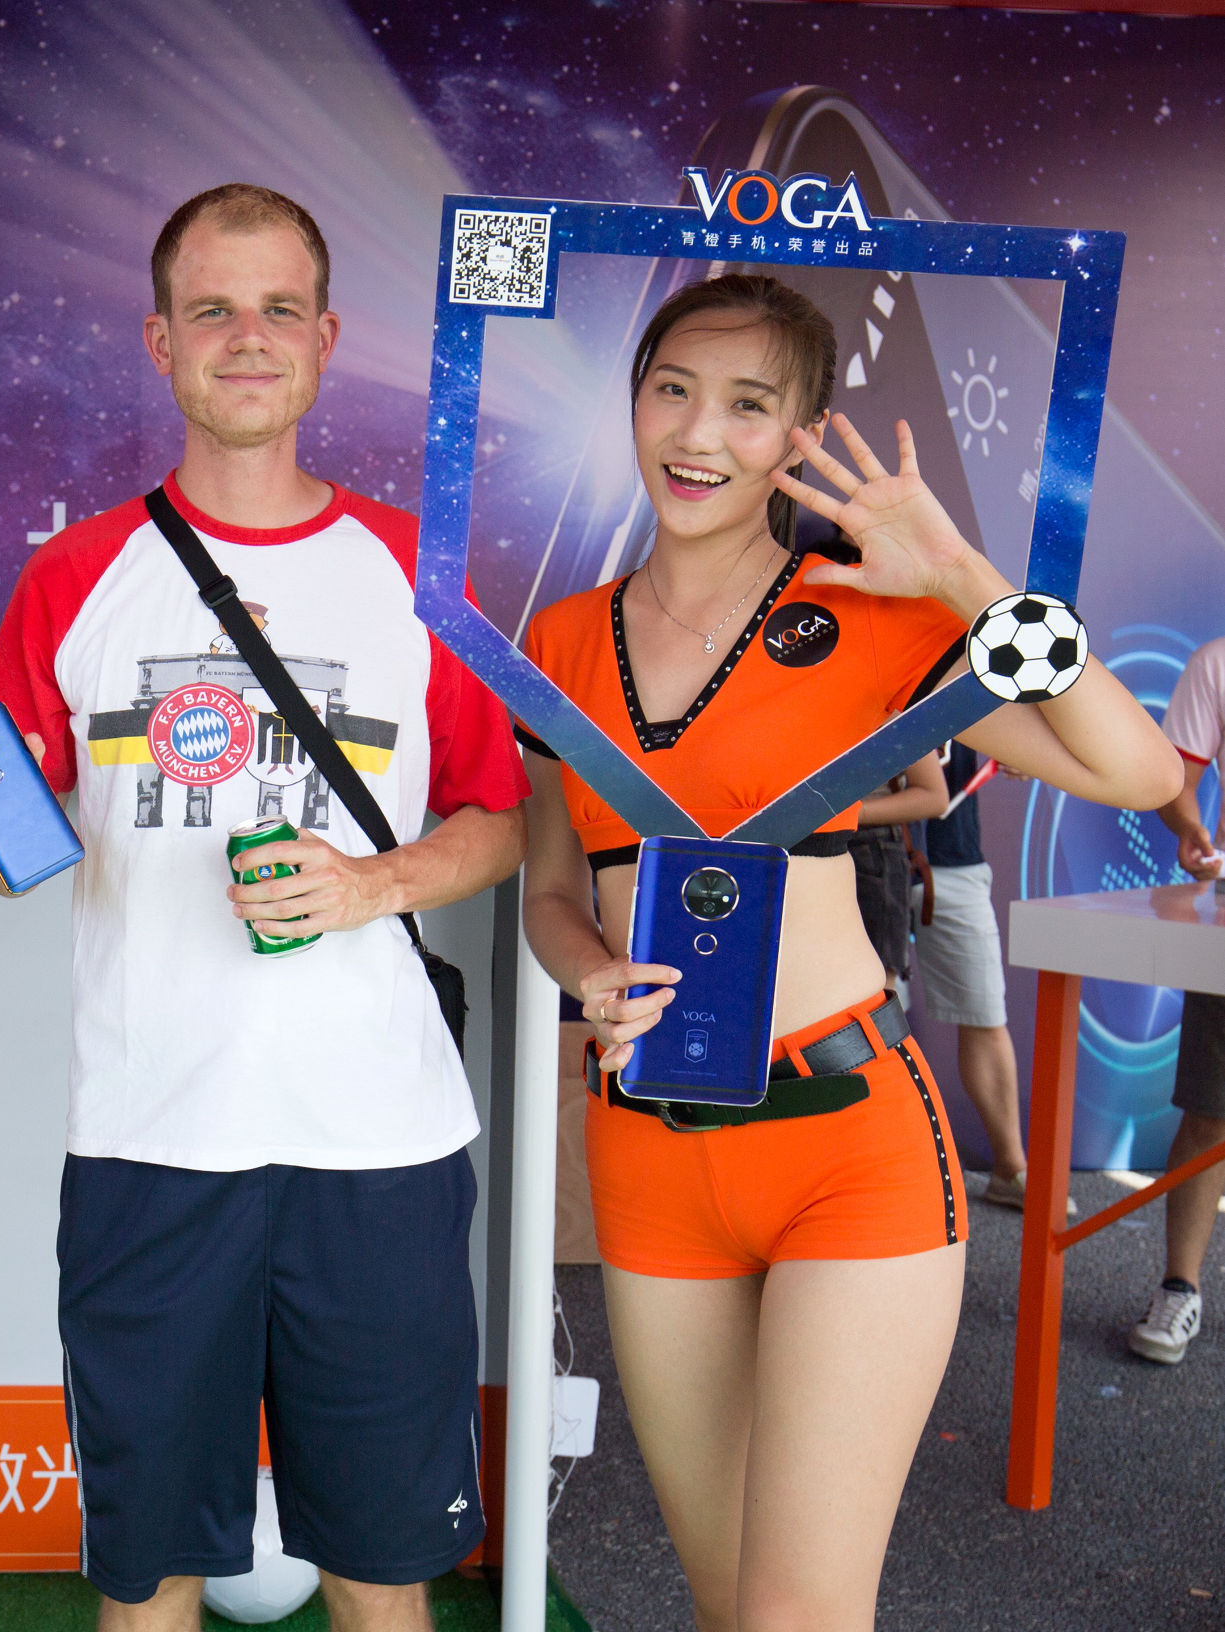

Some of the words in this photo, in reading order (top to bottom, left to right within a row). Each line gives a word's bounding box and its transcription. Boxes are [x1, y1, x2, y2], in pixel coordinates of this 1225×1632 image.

[687, 172, 873, 232] VOGA
[766, 615, 830, 650] VOGA
[183, 691, 245, 728] BAYERN
[156, 740, 221, 778] MÜNCHEN
[682, 1010, 716, 1023] VOGA
